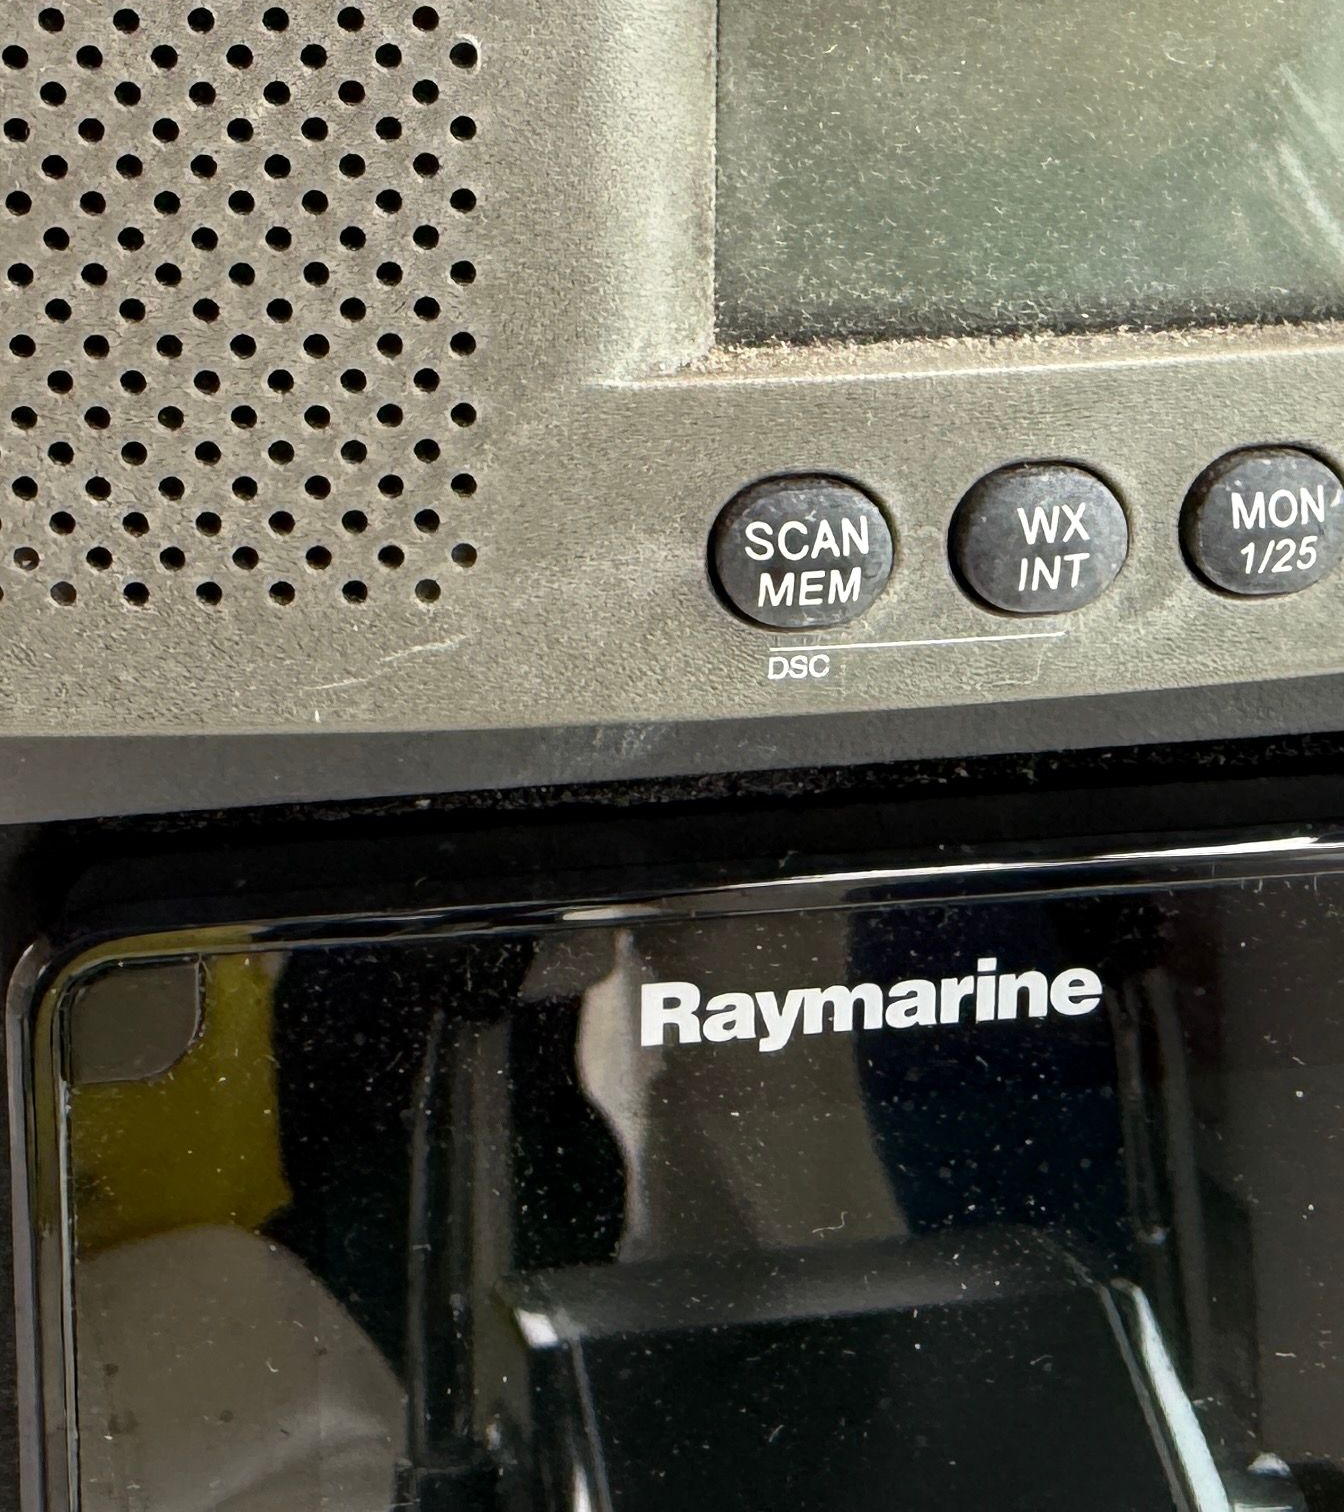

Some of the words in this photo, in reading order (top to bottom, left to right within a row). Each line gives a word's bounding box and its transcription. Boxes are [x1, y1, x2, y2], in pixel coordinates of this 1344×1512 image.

[1016, 501, 1091, 545] WX
[1230, 484, 1326, 530] MON
[744, 515, 870, 561] SCAN
[1239, 535, 1319, 574] 1/25
[757, 566, 863, 608] MEM
[1018, 552, 1090, 592] INT
[767, 654, 831, 680] DSC
[640, 956, 1104, 1053] Raymarine
